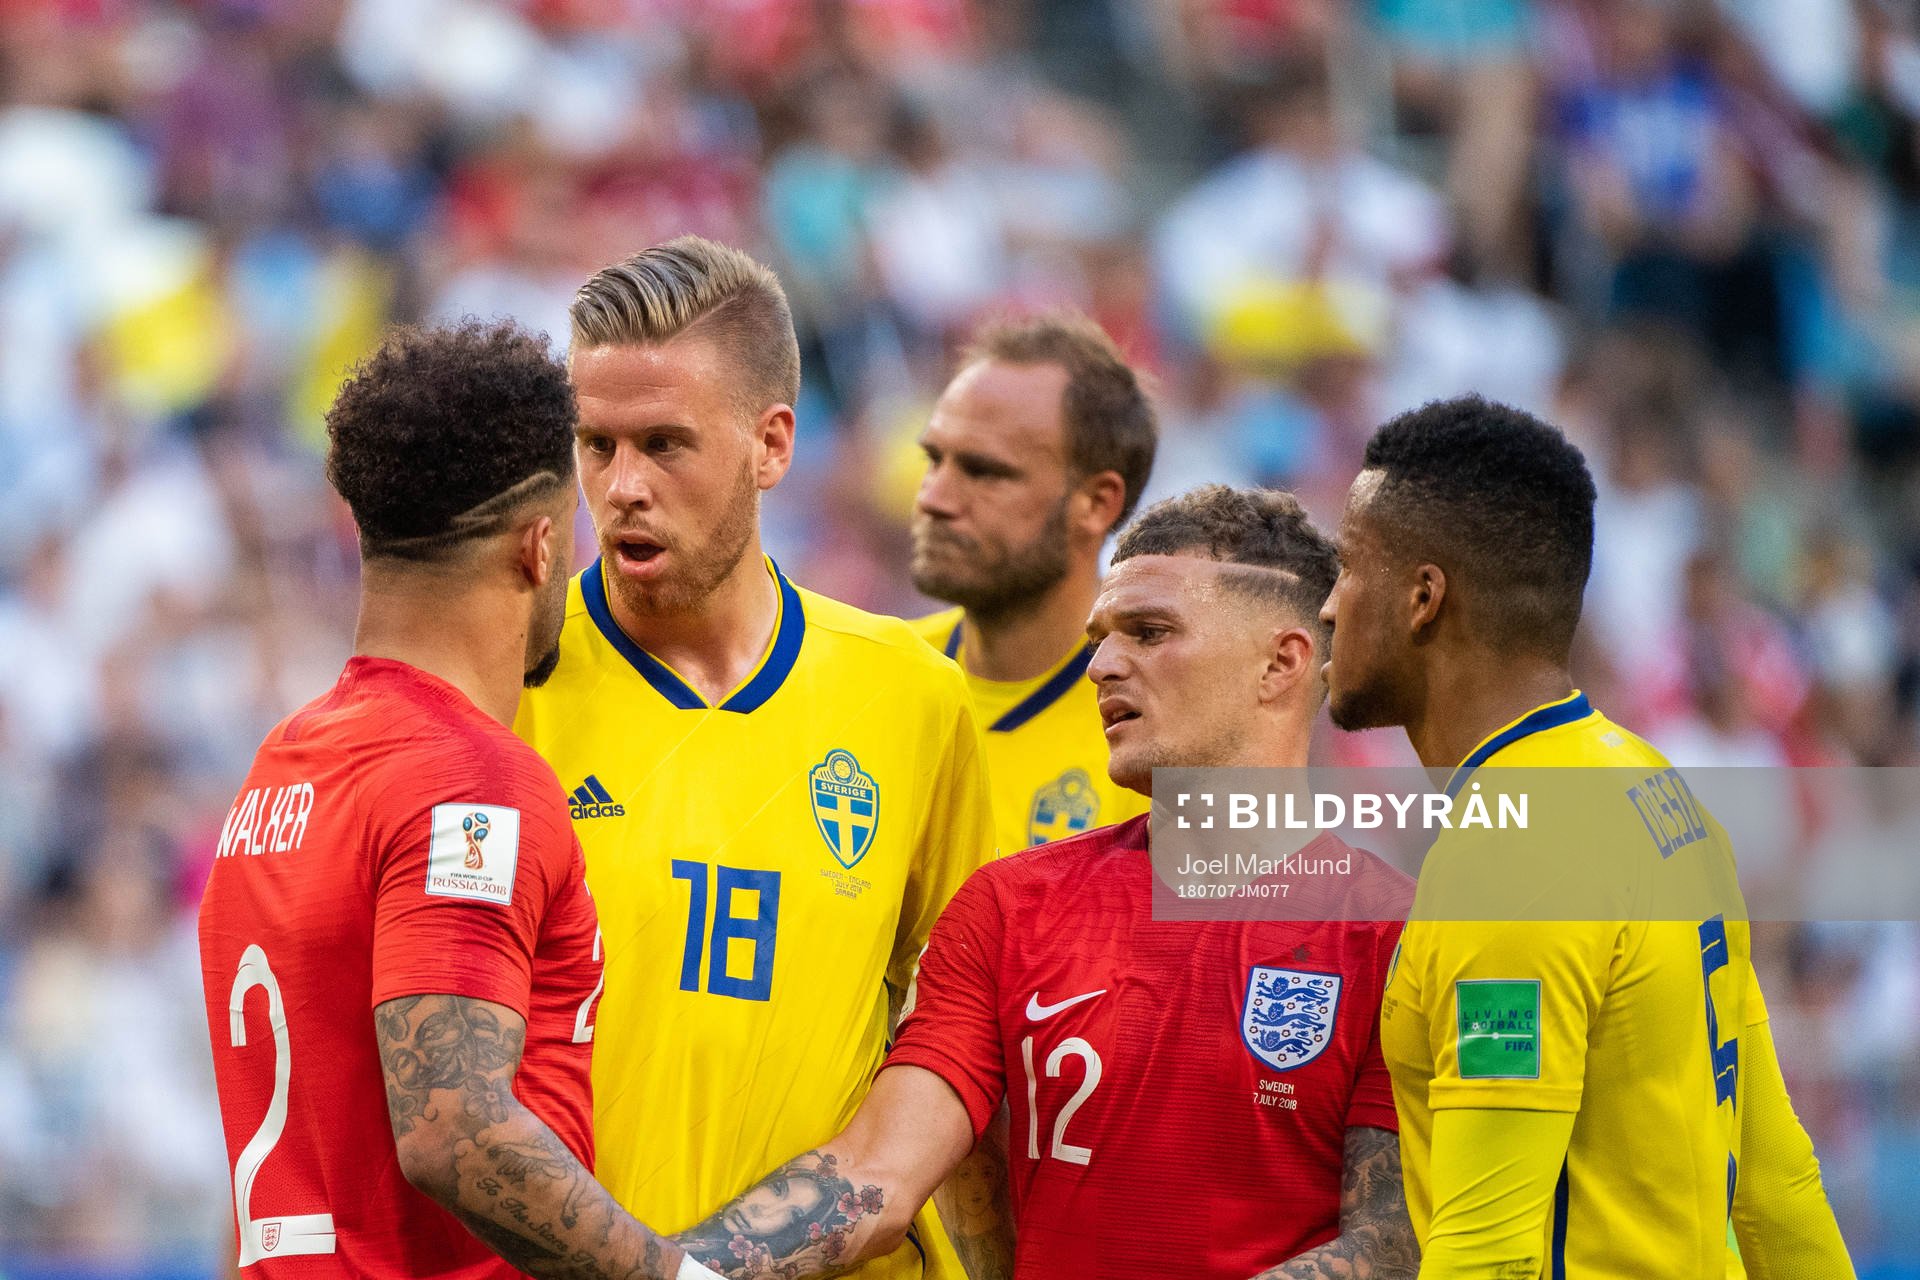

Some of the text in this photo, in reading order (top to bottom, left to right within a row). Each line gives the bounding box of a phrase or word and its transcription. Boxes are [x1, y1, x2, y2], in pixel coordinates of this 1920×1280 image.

[820, 782, 867, 799] SVERIGE
[216, 782, 315, 859] WALKER
[570, 803, 626, 820] didas
[1625, 767, 1708, 860] OLSSO
[433, 877, 507, 896] RUSSIA 2018
[463, 873, 482, 881] WORLD
[671, 858, 782, 1002] 18
[1463, 1009, 1534, 1020] LIVING
[1505, 1041, 1534, 1052] FIFA
[1259, 1079, 1295, 1095] SWEDEN
[229, 943, 337, 1268] 2
[1021, 1035, 1103, 1166] 12
[1253, 1092, 1298, 1111] 7 JULY 2018
